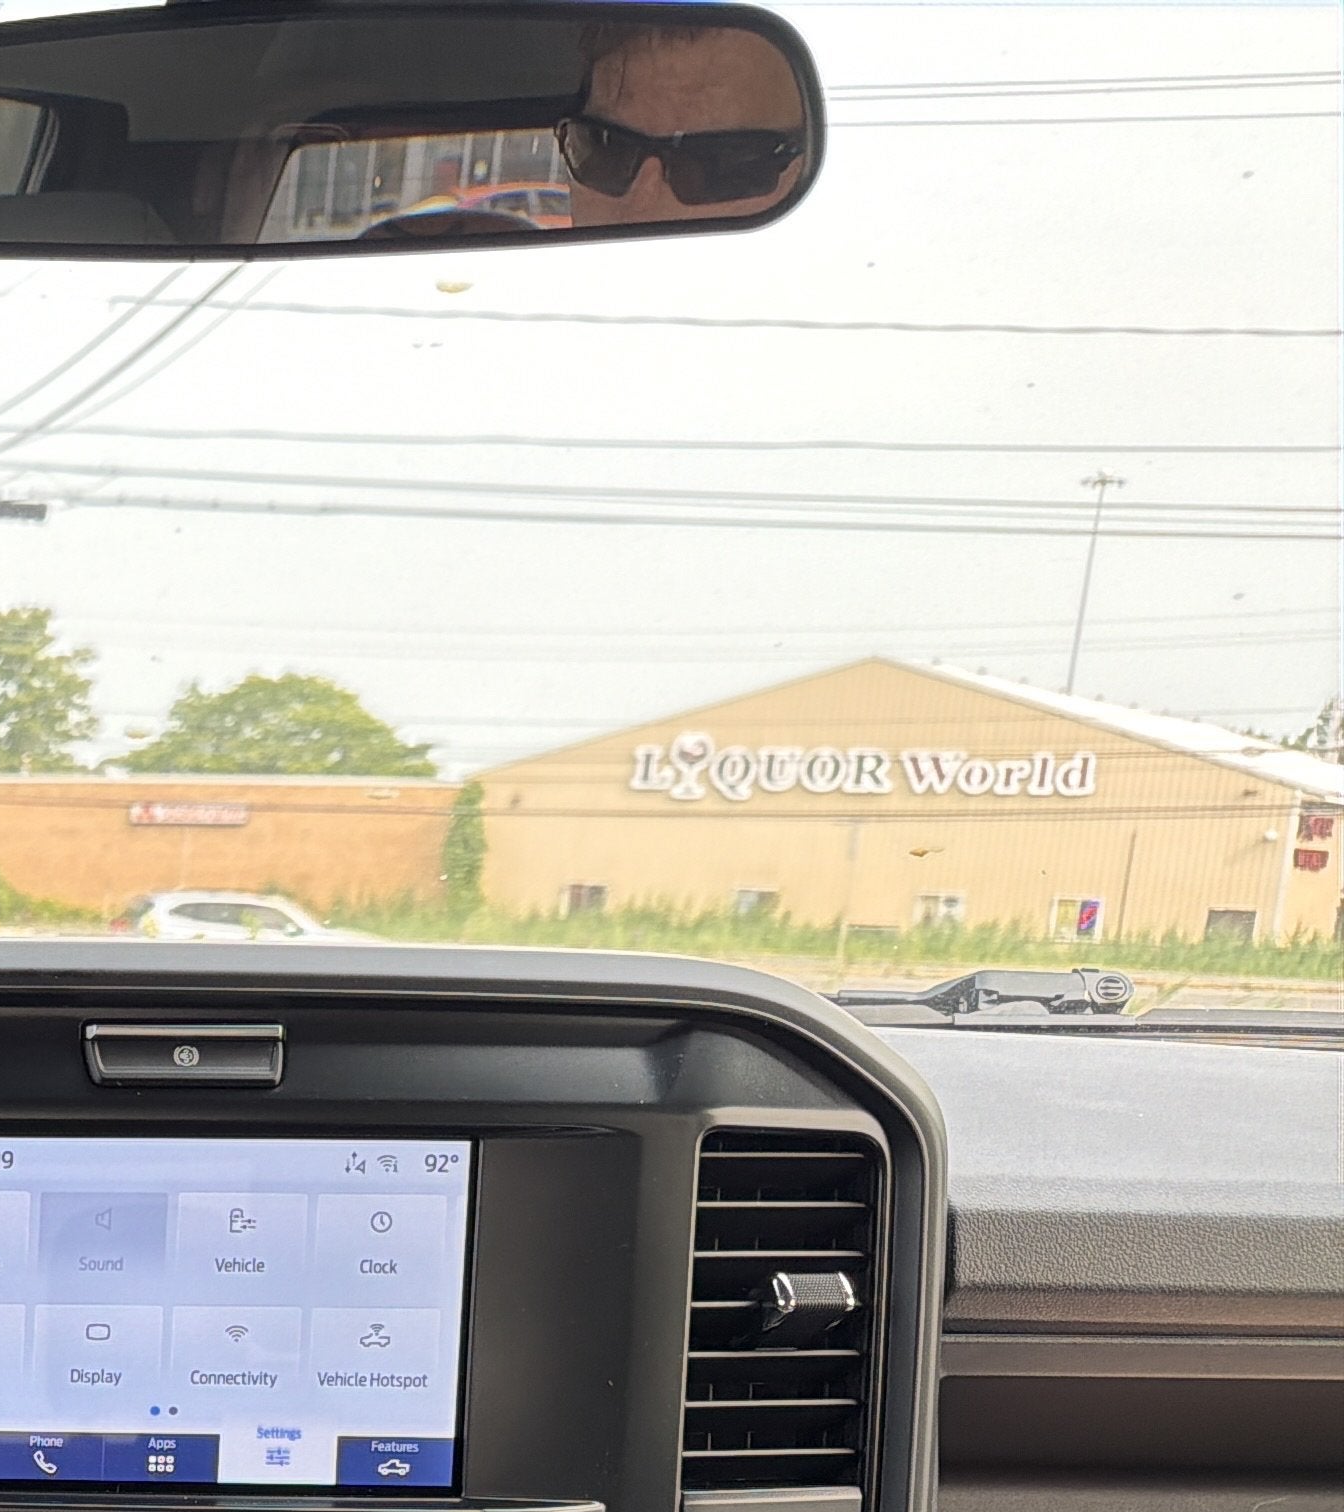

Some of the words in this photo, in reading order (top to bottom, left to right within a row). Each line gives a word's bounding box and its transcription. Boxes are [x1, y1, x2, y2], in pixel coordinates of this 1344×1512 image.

[900, 749, 1098, 799] World
[78, 1256, 124, 1272] Sound
[215, 1257, 265, 1273] Vehicle
[359, 1258, 398, 1275] Clock
[70, 1368, 123, 1388] Display
[190, 1369, 278, 1390] Connectivity
[317, 1371, 367, 1389] Vehicle
[369, 1371, 429, 1393] Hotspot
[29, 1435, 64, 1449] Phone
[256, 1426, 302, 1443] Settings
[148, 1437, 177, 1453] Apps
[371, 1440, 419, 1454] Features
